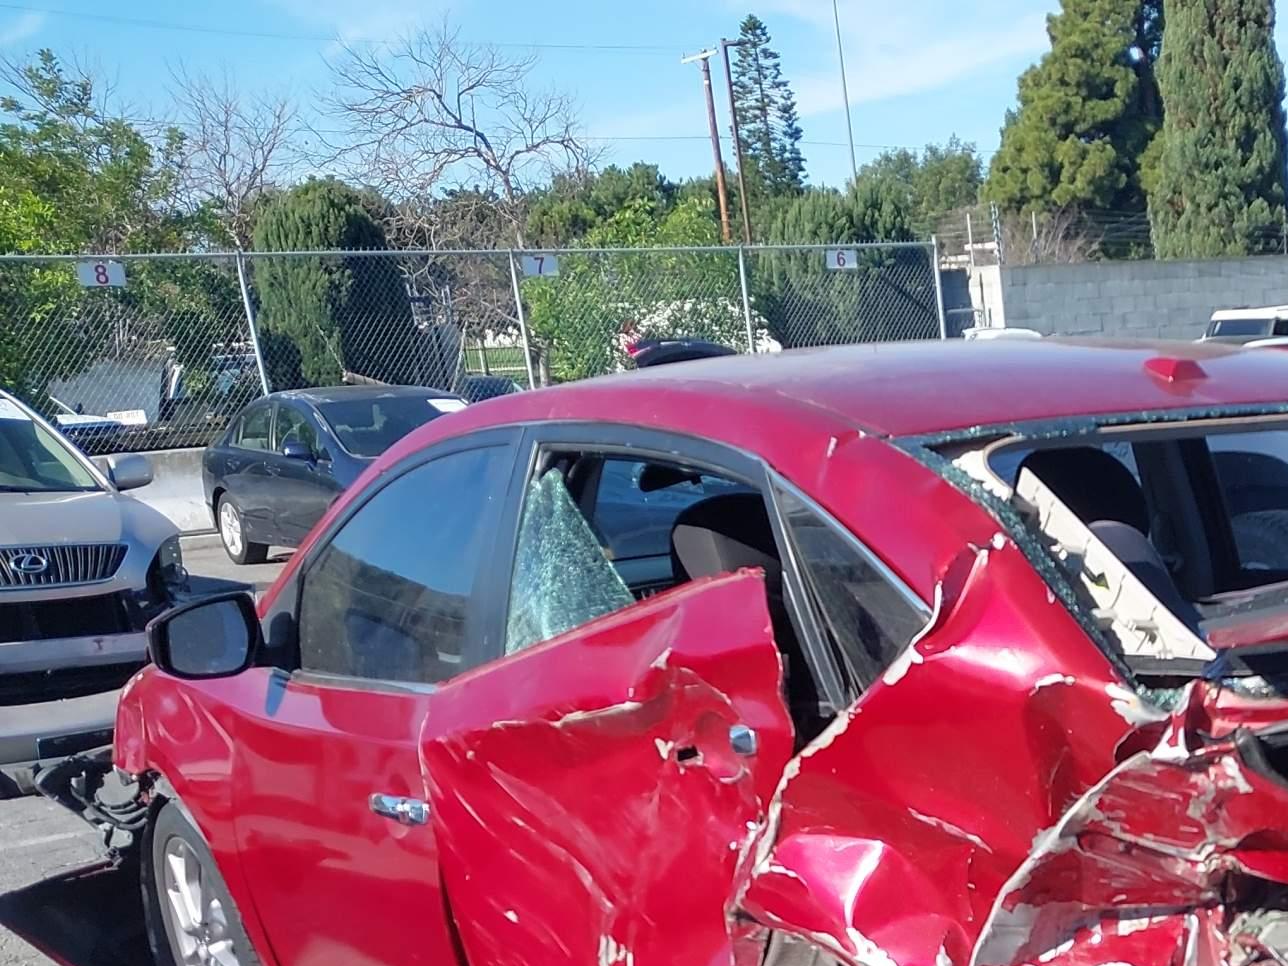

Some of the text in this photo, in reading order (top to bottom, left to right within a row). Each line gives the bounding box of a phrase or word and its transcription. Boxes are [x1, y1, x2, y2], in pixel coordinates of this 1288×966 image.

[533, 256, 545, 274] 7
[836, 251, 846, 267] 6
[94, 264, 109, 285] 8
